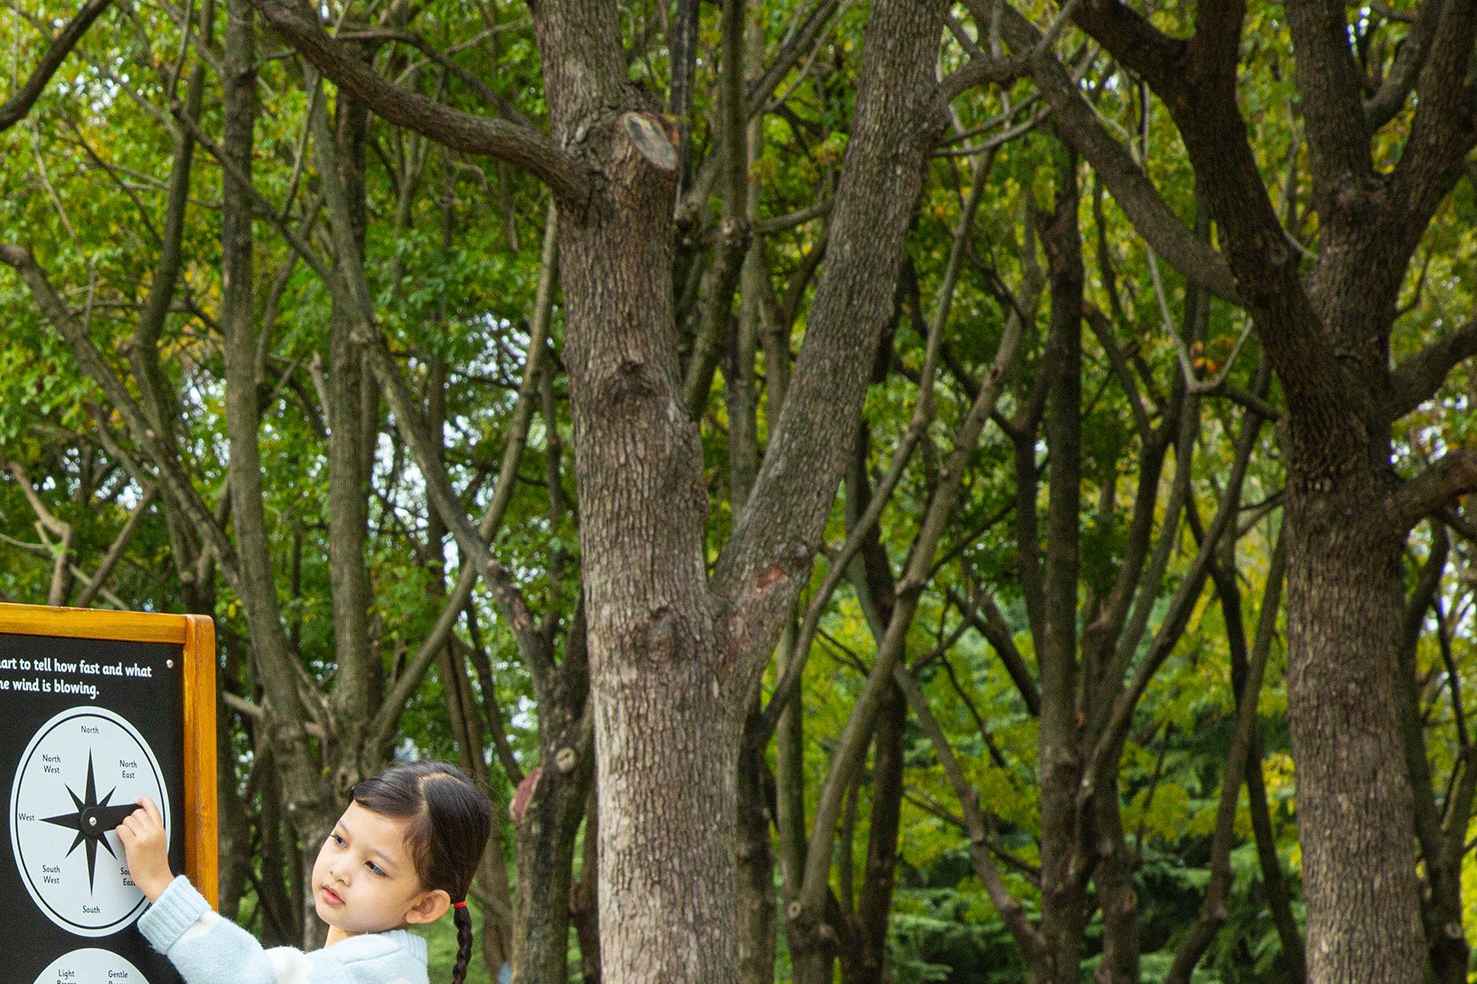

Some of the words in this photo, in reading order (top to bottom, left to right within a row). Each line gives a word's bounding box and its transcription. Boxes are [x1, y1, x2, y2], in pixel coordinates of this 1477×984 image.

[18, 658, 32, 671] to
[33, 657, 52, 672] tell
[53, 657, 78, 673] how
[78, 659, 101, 675] fast
[102, 661, 124, 676] and
[124, 662, 153, 678] what
[12, 677, 40, 692] wind
[42, 678, 52, 693] is
[53, 678, 100, 700] blowing.
[81, 726, 99, 734] North
[43, 755, 61, 763] North
[120, 760, 137, 768] North
[44, 766, 60, 774] West
[122, 771, 135, 779] East
[19, 813, 35, 821] West
[43, 865, 61, 873] South
[44, 876, 60, 884] West
[83, 906, 100, 914] South
[59, 970, 75, 979] Light
[108, 970, 128, 979] Gentle
